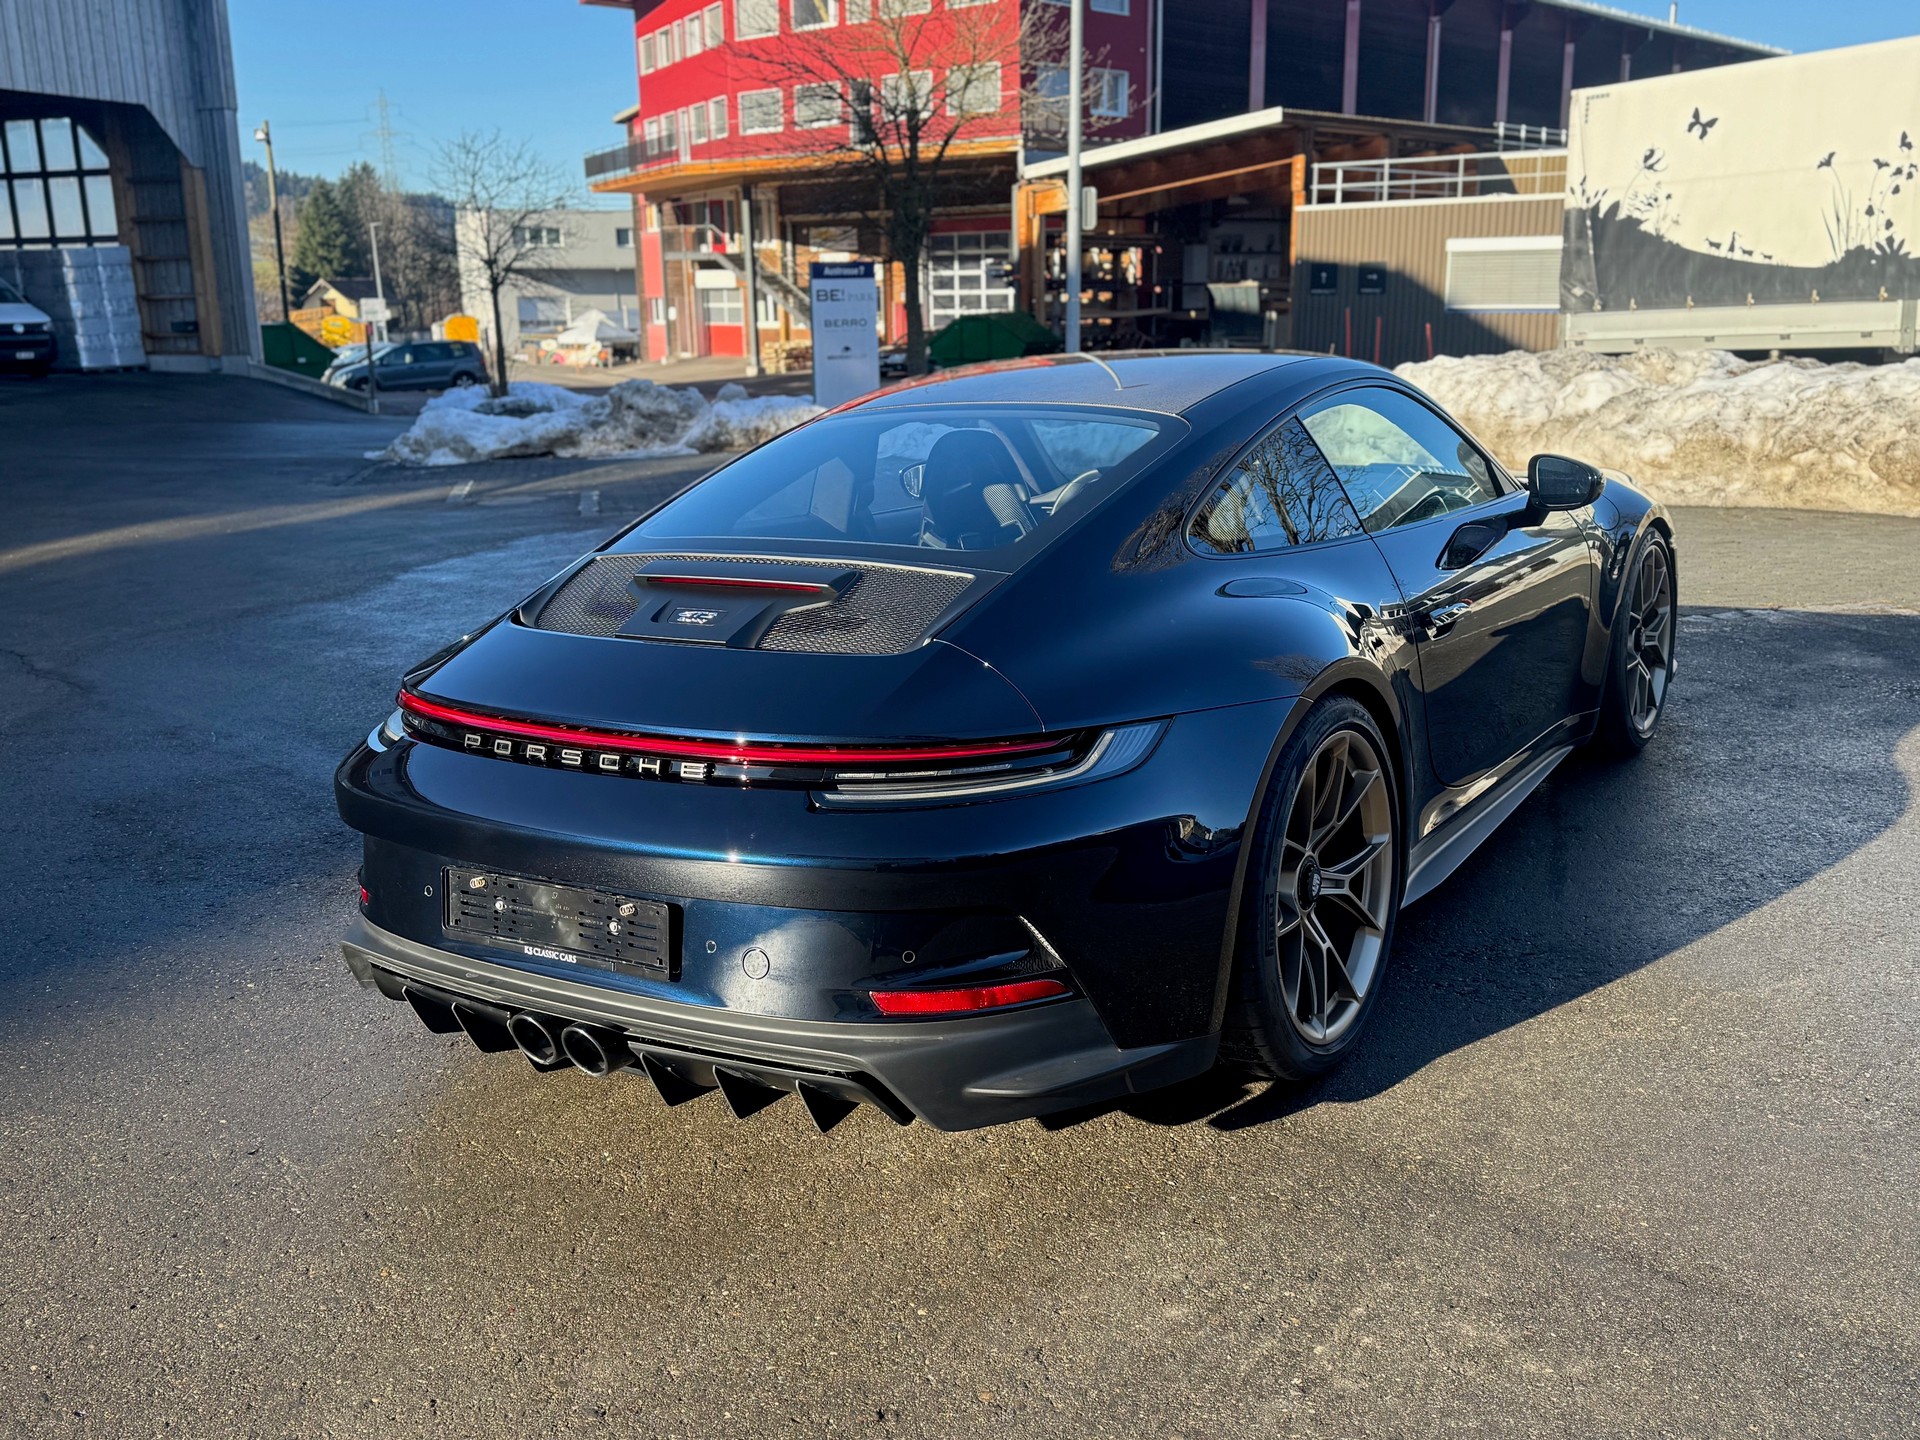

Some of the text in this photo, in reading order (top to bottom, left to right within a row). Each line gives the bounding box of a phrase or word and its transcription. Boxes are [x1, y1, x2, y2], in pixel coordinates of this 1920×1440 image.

[824, 318, 868, 328] BERRO
[464, 733, 708, 780] PORSCHE
[533, 947, 560, 961] CLASSIC
[559, 953, 578, 964] CARS
